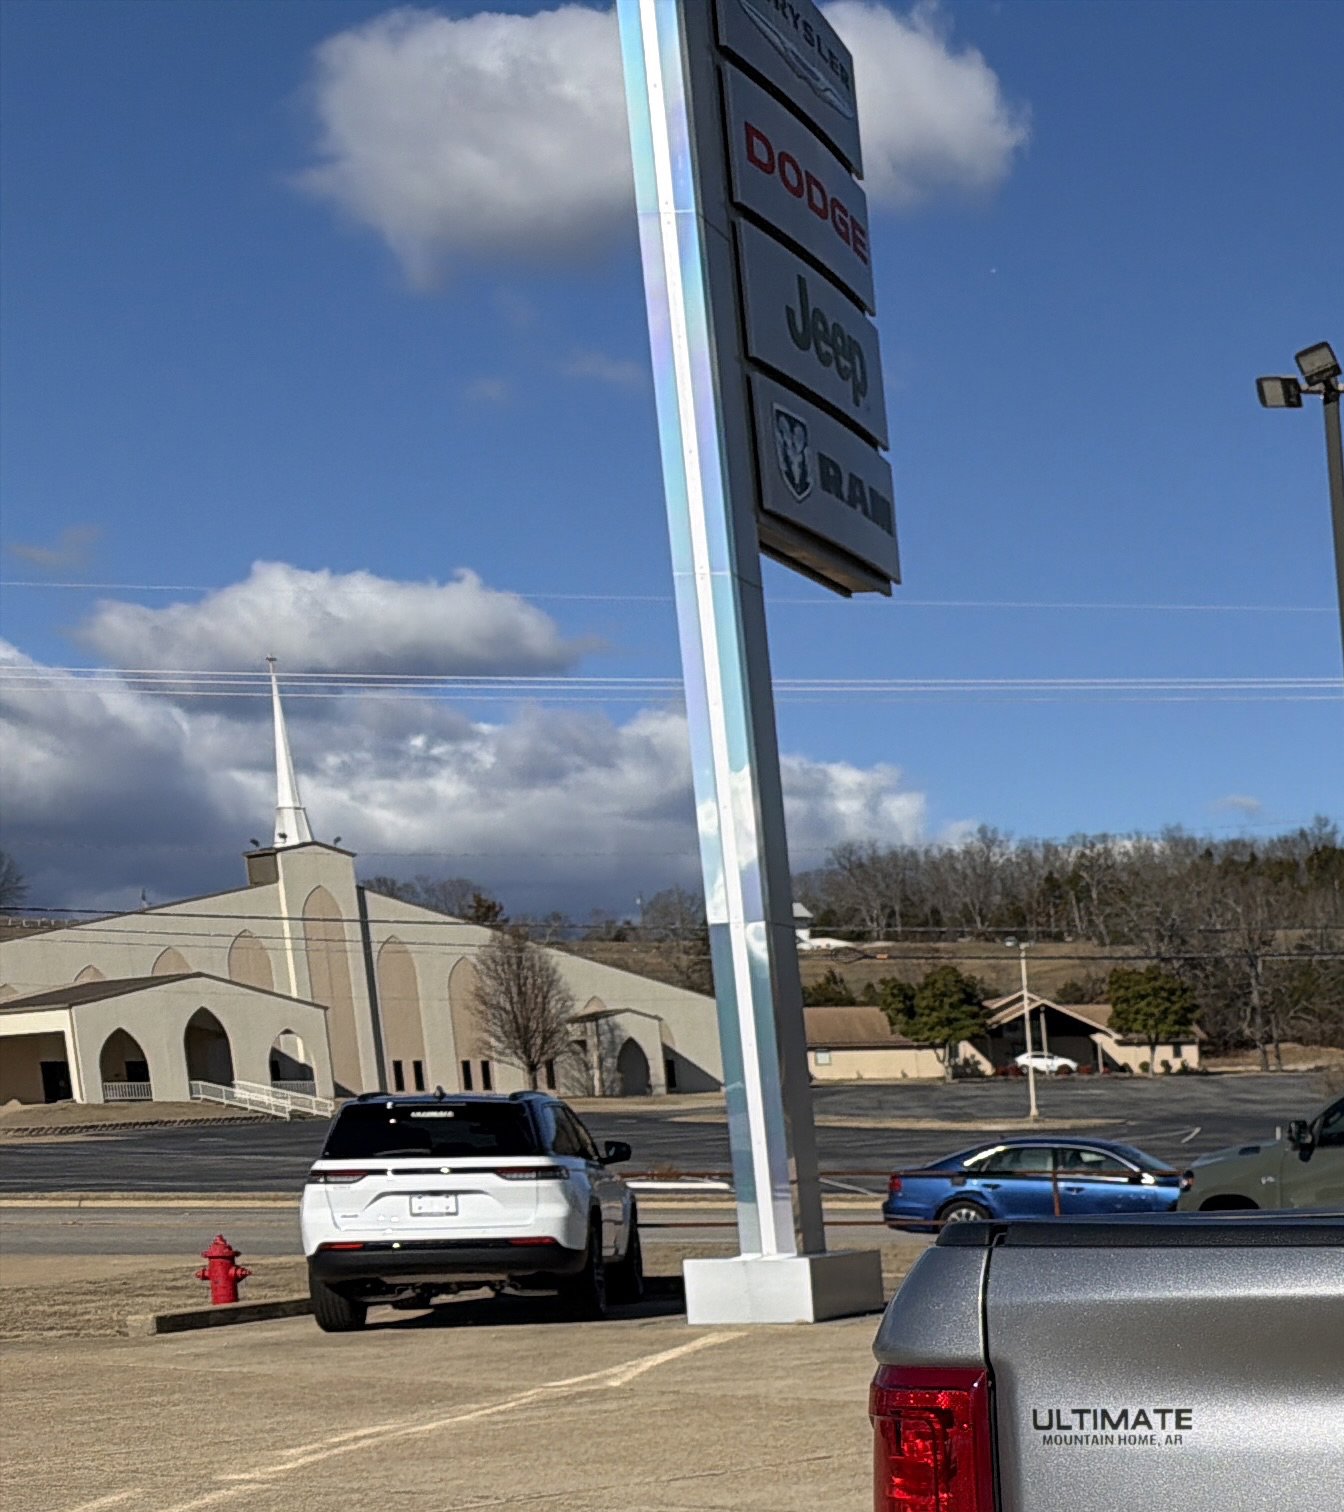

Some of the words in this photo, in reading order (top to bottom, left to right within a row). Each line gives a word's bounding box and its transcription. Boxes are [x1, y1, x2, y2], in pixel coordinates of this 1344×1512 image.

[745, 121, 869, 266] DODGE
[786, 274, 868, 407] Jeep
[817, 452, 894, 537] RAM
[1032, 1408, 1193, 1431] ULTIMATE
[1042, 1434, 1114, 1446] MOUNTAIN
[1118, 1434, 1161, 1448] HOME,
[1165, 1434, 1183, 1446] AR
